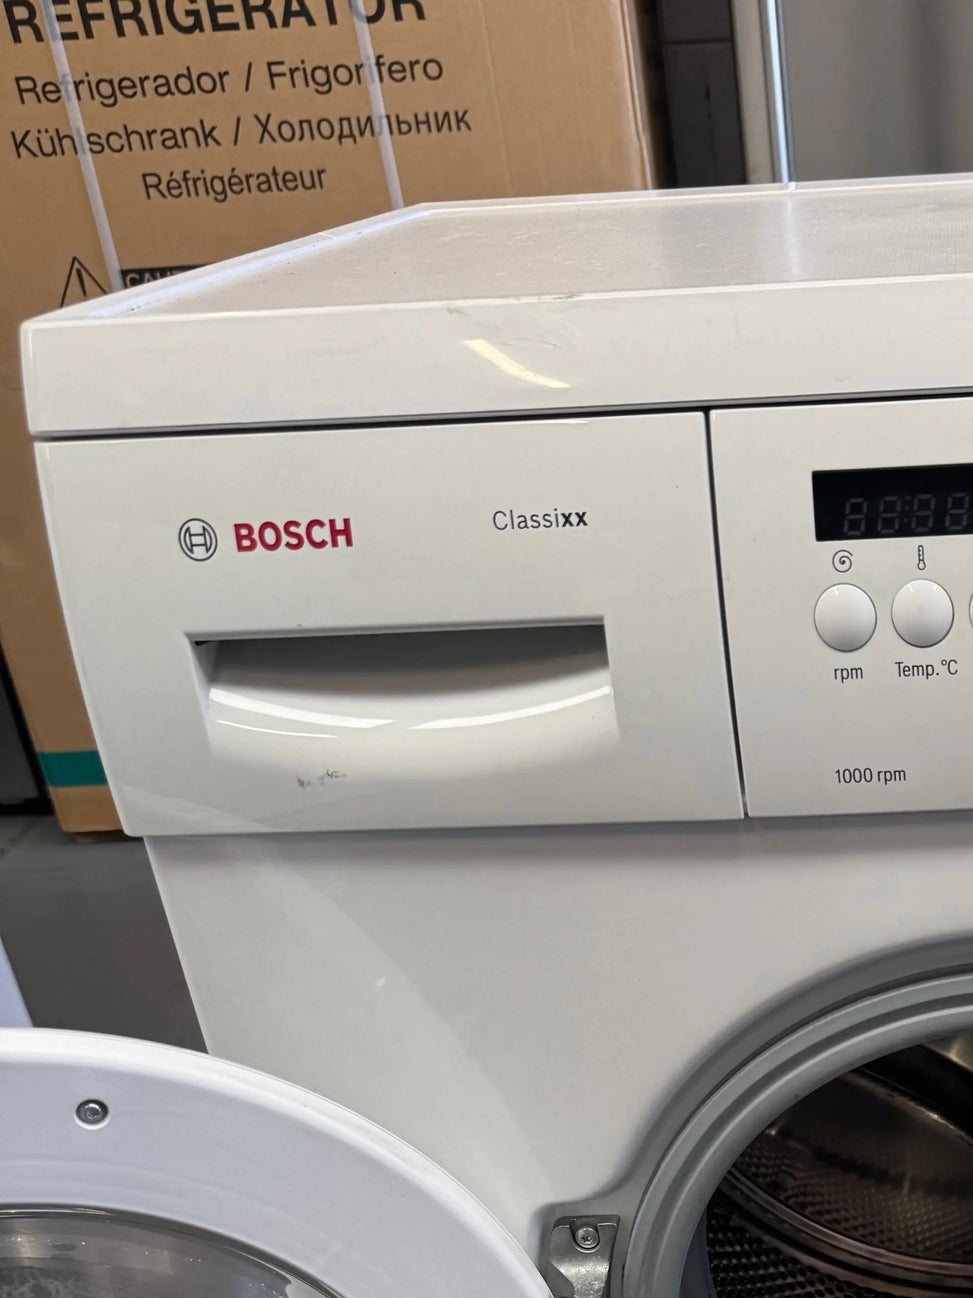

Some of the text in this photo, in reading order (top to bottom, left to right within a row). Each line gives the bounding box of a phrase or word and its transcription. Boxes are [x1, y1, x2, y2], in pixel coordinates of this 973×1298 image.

[14, 66, 230, 108] Refrigerador
[11, 118, 222, 159] Kühlschrank
[253, 109, 473, 146] Холодильник
[141, 165, 327, 202] Réfrigérateur
[233, 517, 354, 554] BOSCH
[492, 508, 589, 532] Classixx
[834, 667, 864, 683] rpm
[835, 768, 907, 785] 1000 rpm
